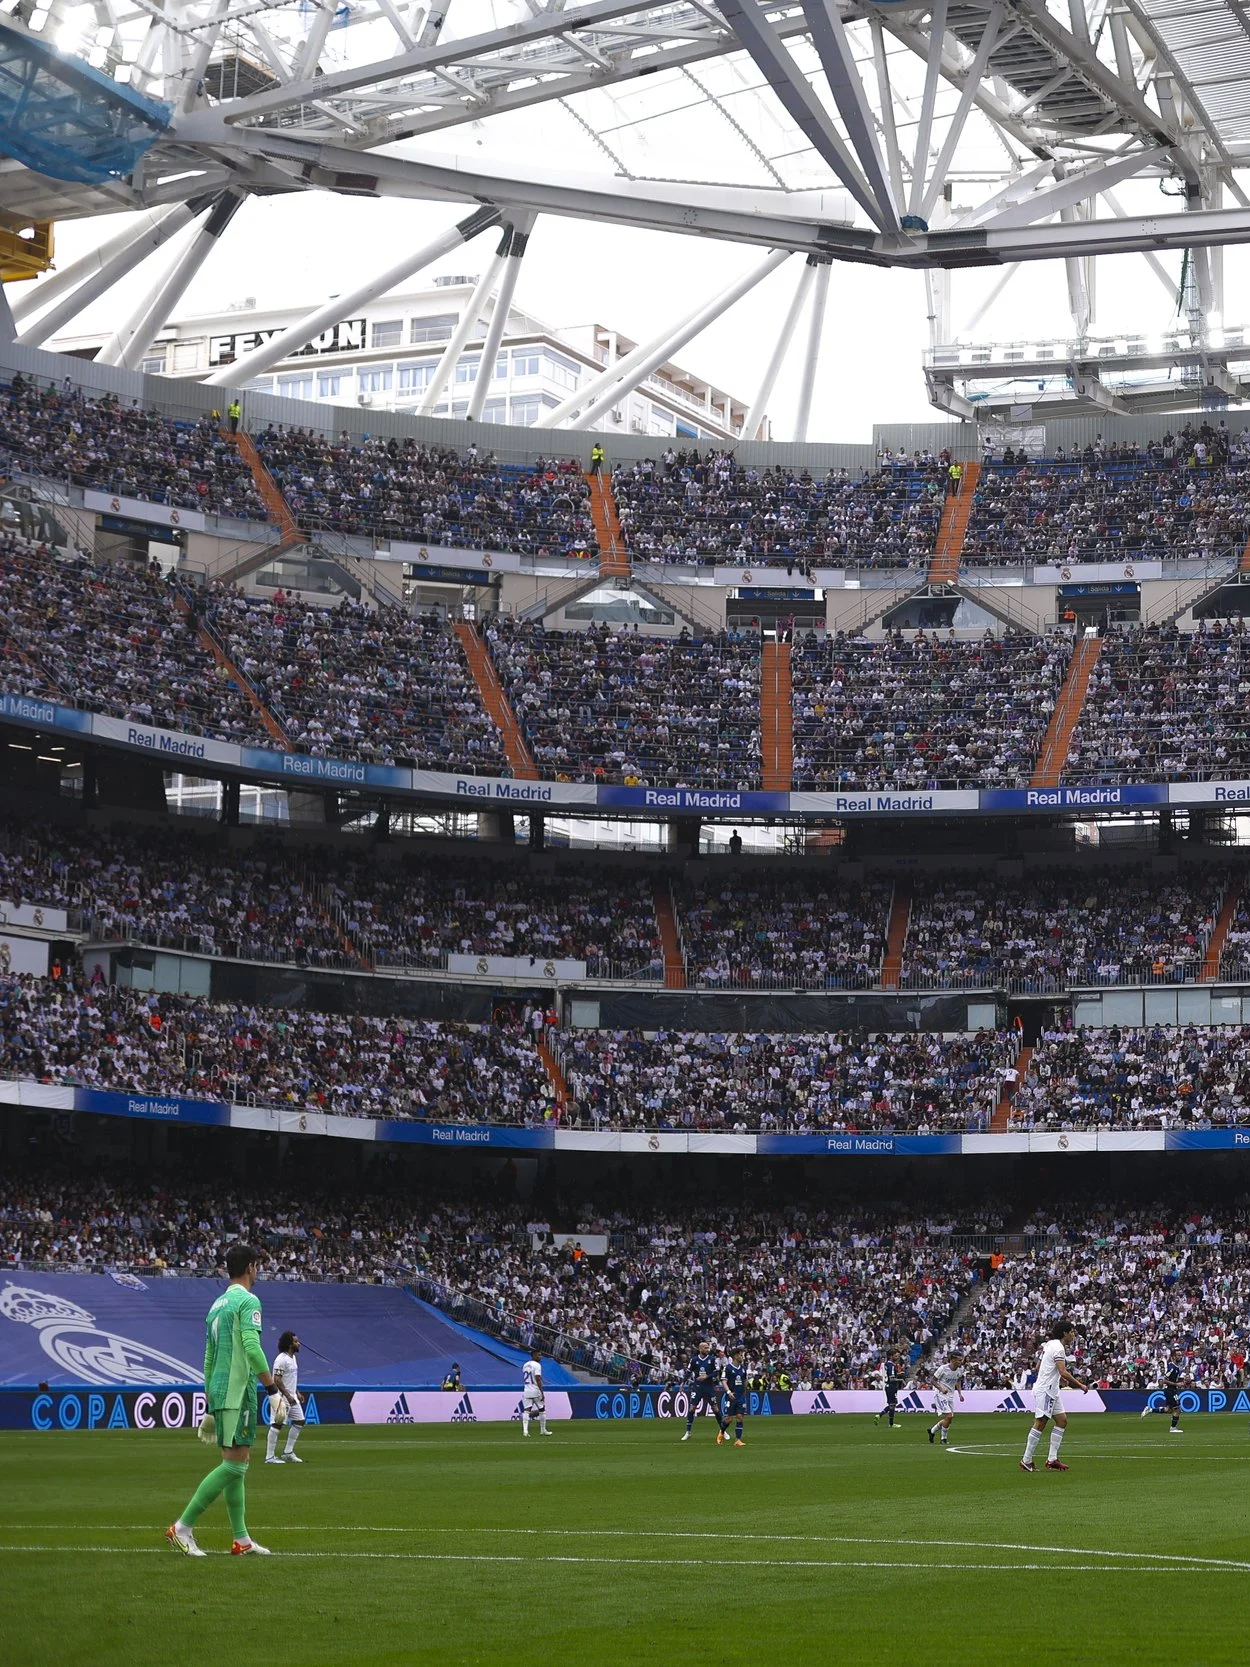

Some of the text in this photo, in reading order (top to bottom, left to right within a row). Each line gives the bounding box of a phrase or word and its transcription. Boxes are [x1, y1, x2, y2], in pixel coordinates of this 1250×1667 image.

[9, 700, 54, 723] Madrid
[128, 728, 205, 757] Real Madrid
[283, 755, 365, 781] Real Madrid
[456, 780, 552, 801] Real Madrid
[645, 790, 741, 808] Real Madrid
[1027, 788, 1121, 805] Real Madrid
[1215, 786, 1250, 801] Real
[836, 796, 933, 811] Real Madrid
[128, 1100, 179, 1116] Real Madrid
[432, 1129, 490, 1142] Real Madrid
[828, 1139, 893, 1150] Real Madrid
[523, 1371, 535, 1385] 21
[31, 1392, 207, 1430] COPA COP
[596, 1393, 655, 1419] COPA
